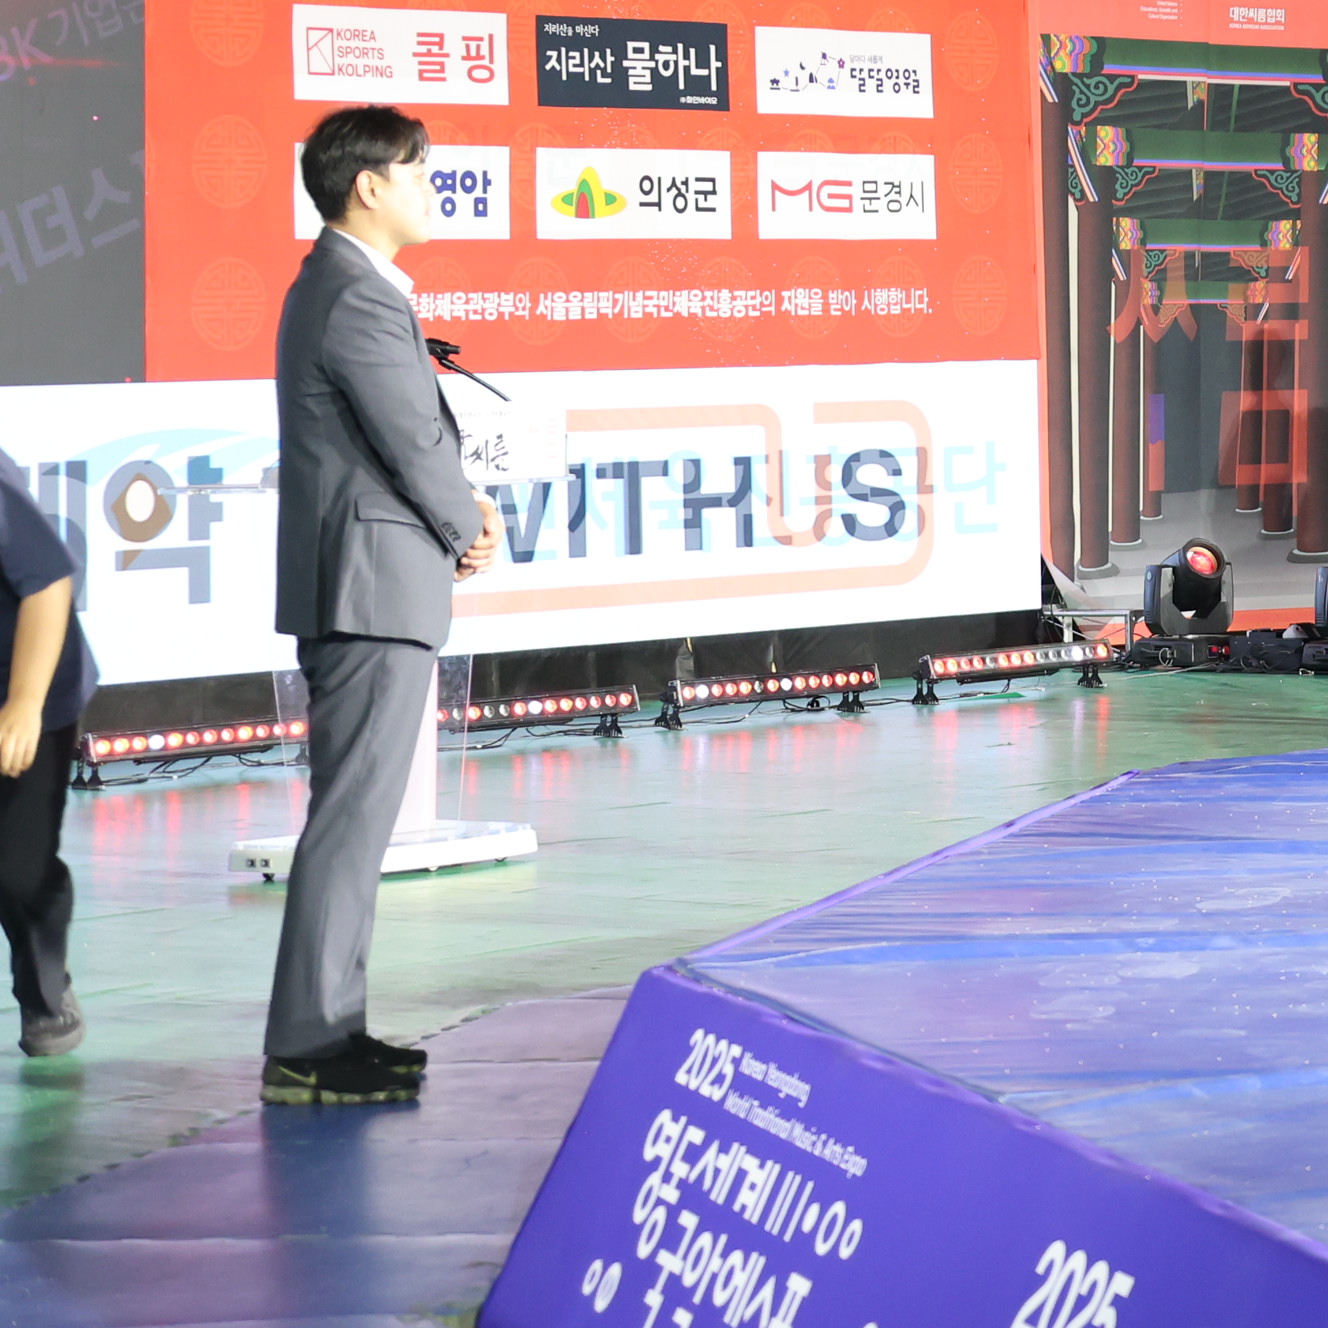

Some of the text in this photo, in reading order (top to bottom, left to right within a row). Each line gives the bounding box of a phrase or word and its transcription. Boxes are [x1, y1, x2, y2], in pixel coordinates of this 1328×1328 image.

[1229, 7, 1285, 23] 대한씨름협회
[336, 28, 376, 43] KOREA
[544, 23, 599, 37] 지리산을 마신다
[337, 46, 384, 60] SPORTS
[545, 41, 722, 91] 지리산 물하나
[337, 63, 393, 79] KOLPING
[430, 170, 492, 218] 영암
[639, 175, 717, 214] 의성군
[771, 179, 925, 213] MG 문경시
[781, 288, 824, 316] 지원을
[828, 288, 857, 316] 받아
[861, 287, 933, 315] 시행합니다.
[674, 1028, 743, 1102] 2025
